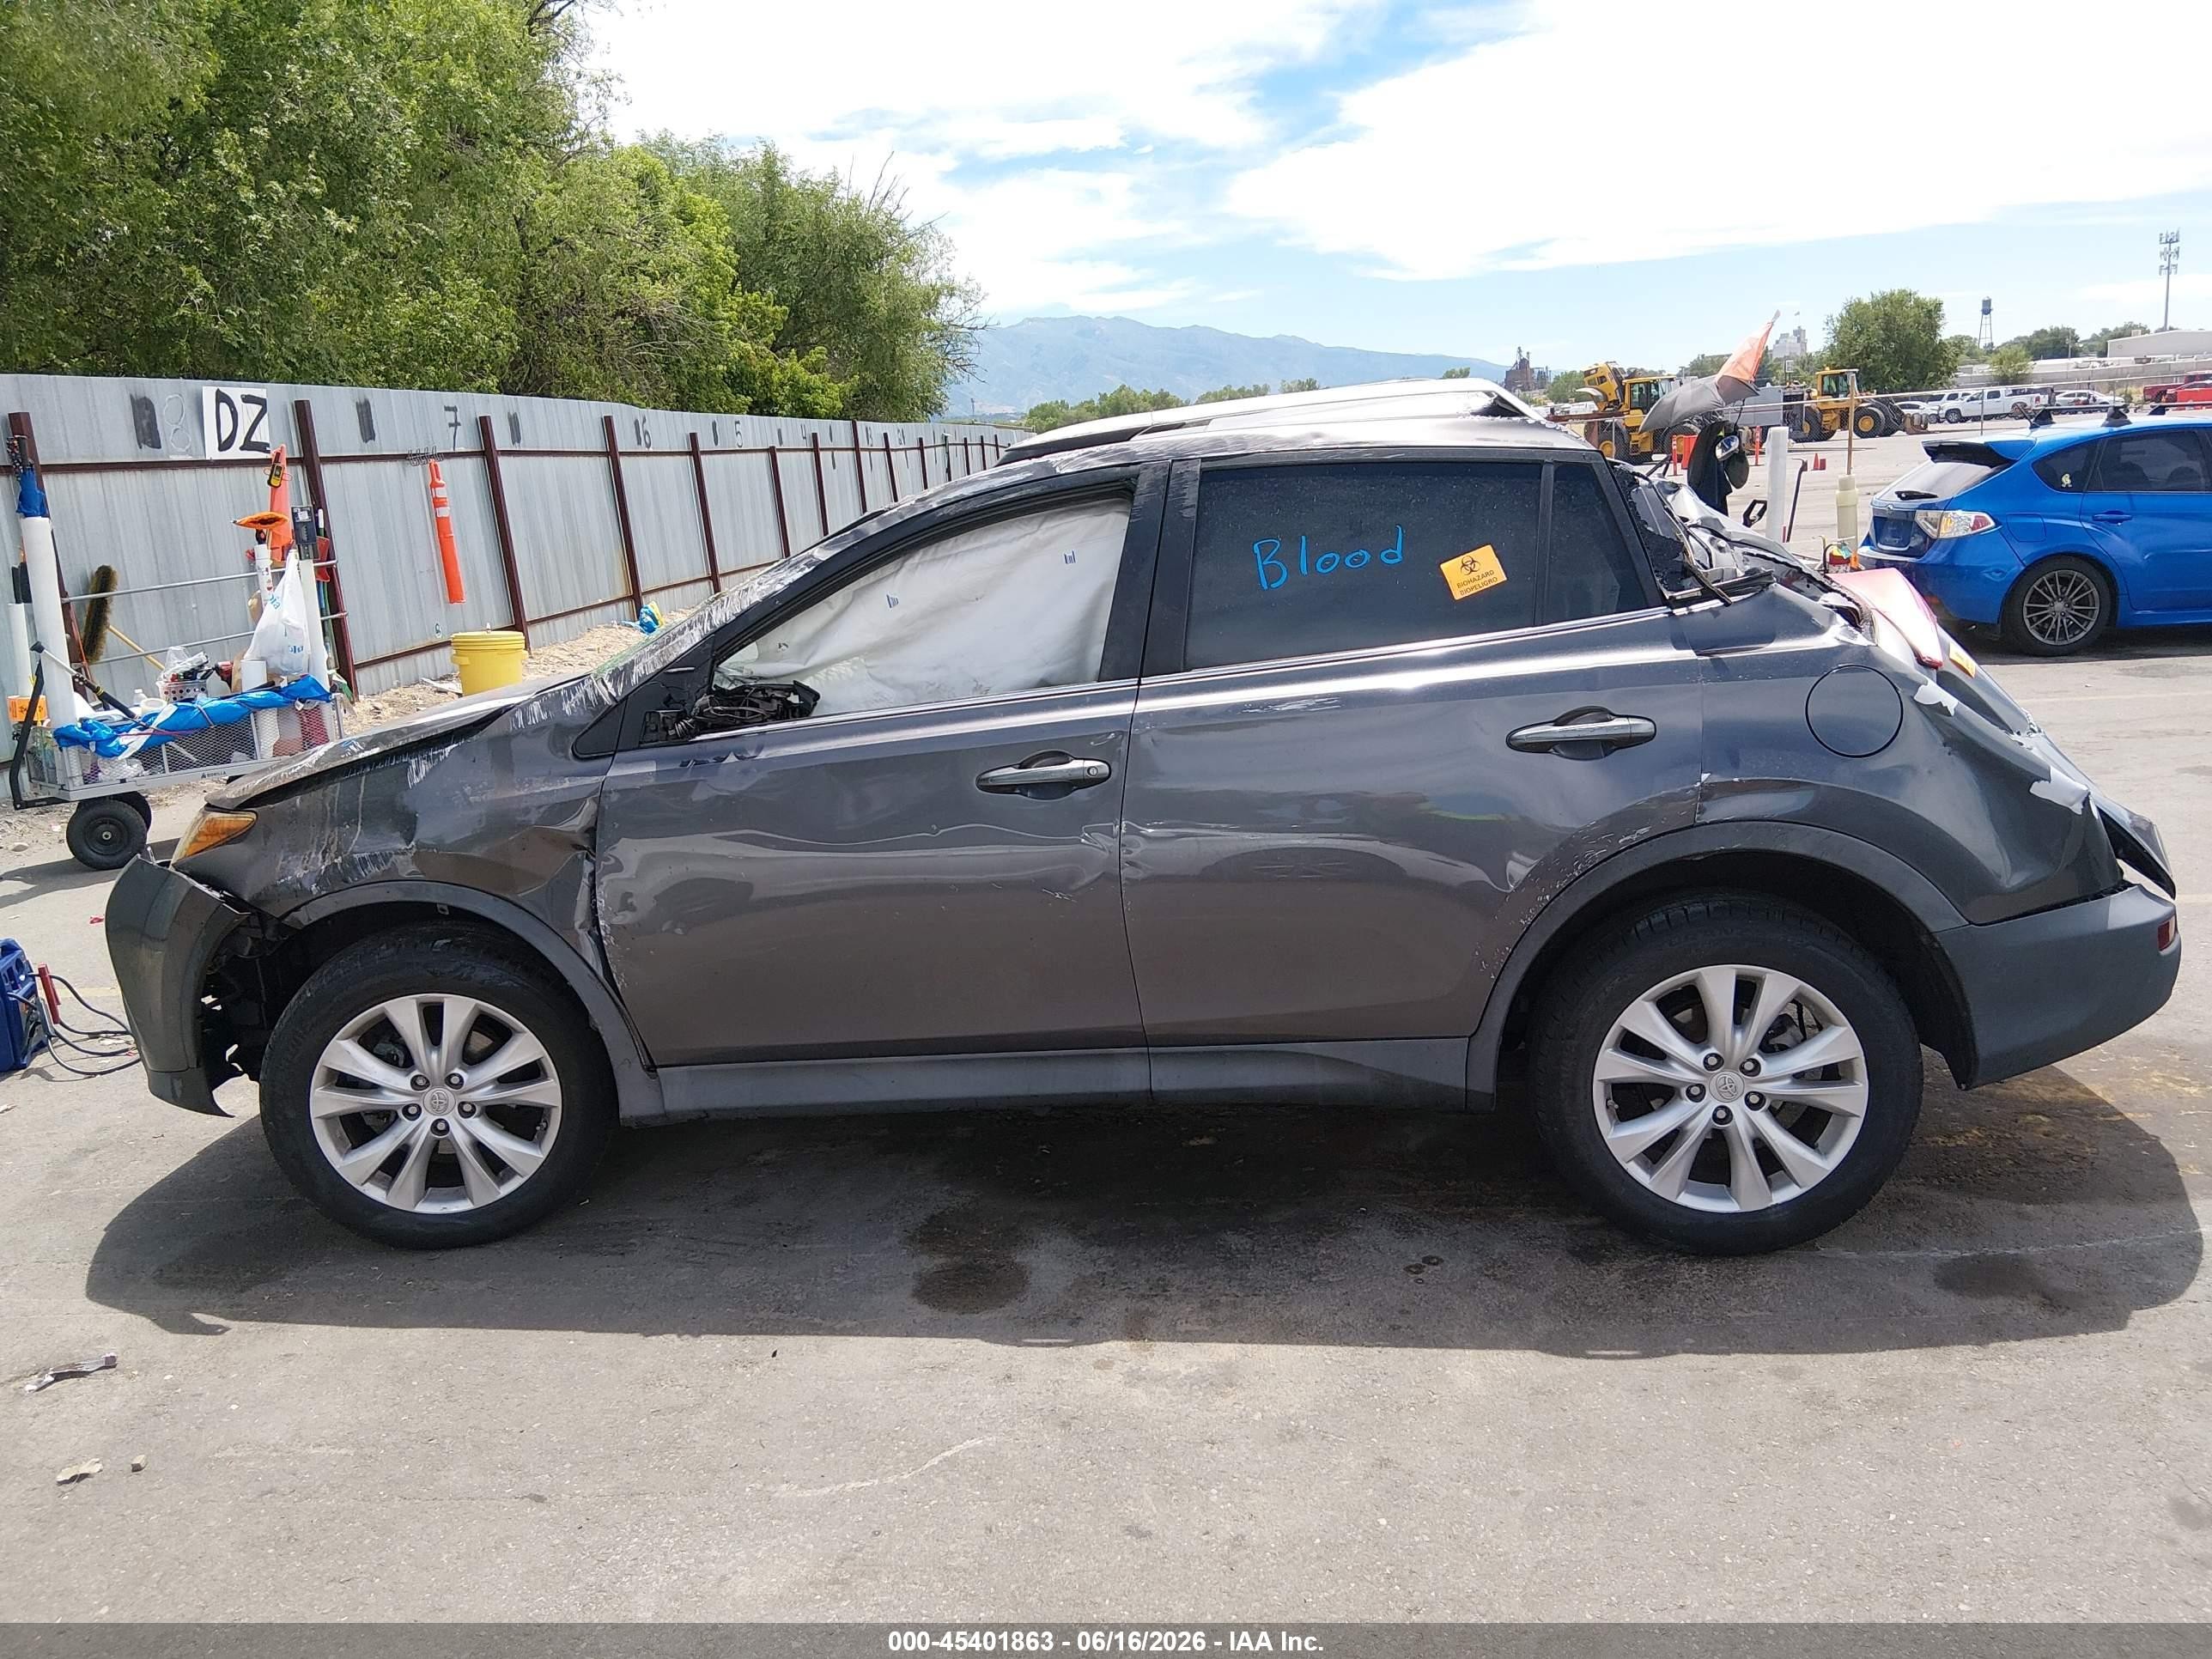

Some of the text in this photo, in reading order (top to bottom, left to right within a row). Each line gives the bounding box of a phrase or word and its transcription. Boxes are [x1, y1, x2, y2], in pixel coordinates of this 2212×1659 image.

[216, 388, 271, 453] DZ
[443, 404, 461, 452] 7
[1252, 523, 1406, 591] Blood
[1456, 569, 1495, 589] BIOHAZARD
[1460, 576, 1498, 596] BIOPELIGRO
